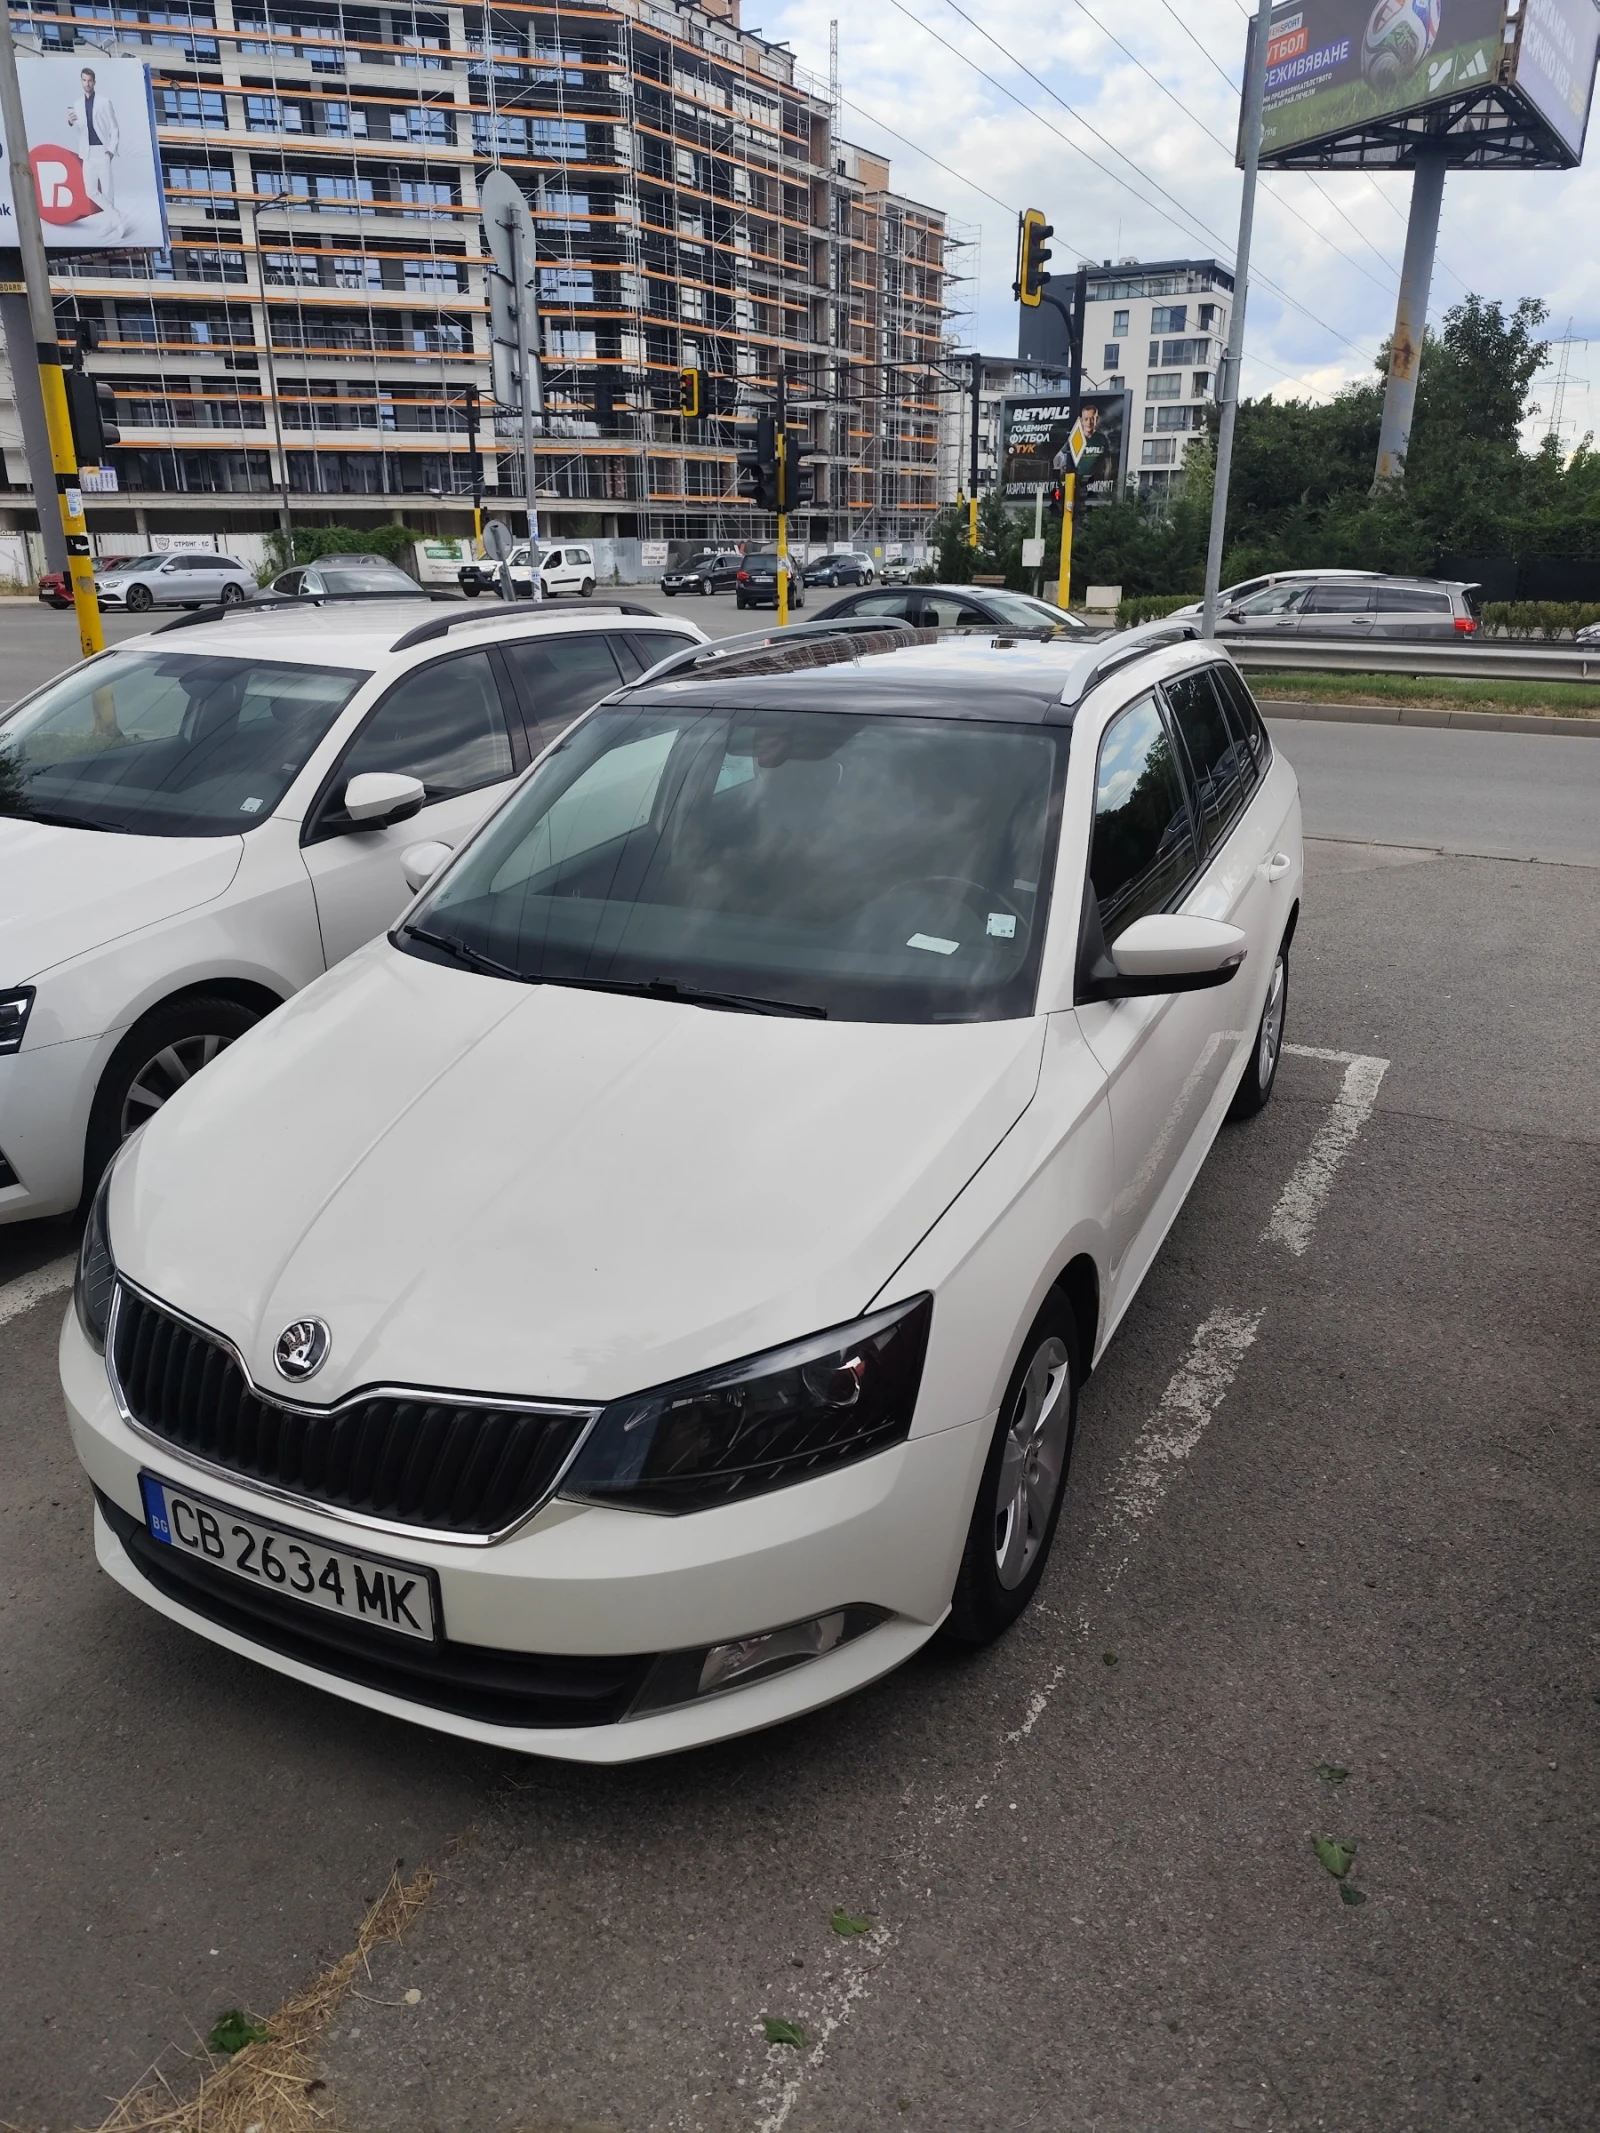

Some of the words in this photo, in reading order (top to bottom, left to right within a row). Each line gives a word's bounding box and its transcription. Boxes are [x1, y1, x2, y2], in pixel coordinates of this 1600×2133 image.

[1269, 17, 1301, 37] TERSPORT
[1266, 32, 1305, 63] УТБОЛ
[1264, 41, 1349, 87] РЕЖИВЯВАНЕ
[1009, 433, 1050, 445] ФУТБОЛ
[1015, 444, 1036, 454] ТУК
[151, 1513, 169, 1534] BG
[171, 1499, 225, 1560] CB
[231, 1525, 345, 1606] 2634
[353, 1564, 422, 1631] MK
